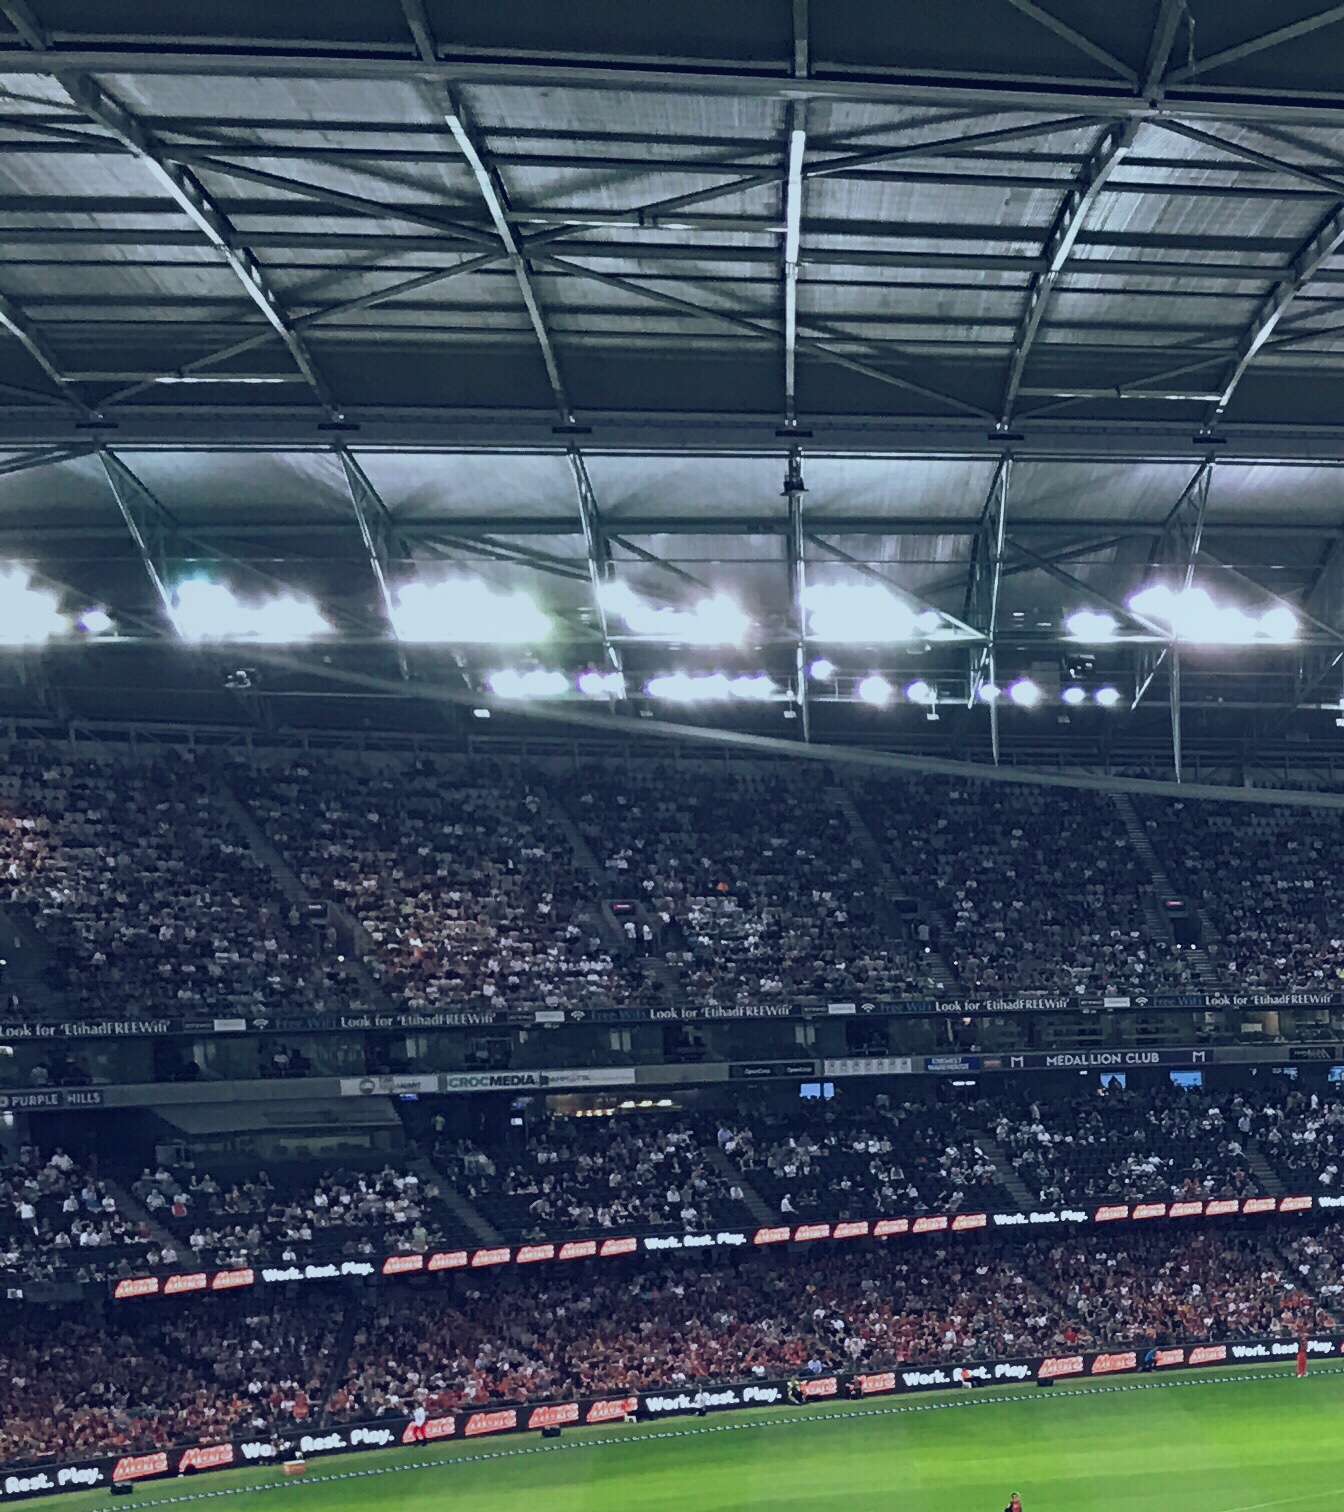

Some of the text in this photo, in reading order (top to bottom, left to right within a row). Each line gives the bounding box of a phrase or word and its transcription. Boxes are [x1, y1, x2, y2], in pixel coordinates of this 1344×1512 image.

[1046, 1054, 1121, 1066] MEDALLION
[1126, 1053, 1160, 1064] CLUB
[448, 1074, 535, 1089] CROCMEDIA
[12, 1092, 100, 1106] PURPLE HILLS
[1232, 1345, 1270, 1357] Work.
[903, 1364, 1031, 1386] Work. Play.
[744, 1387, 781, 1402] Play.
[300, 1433, 346, 1455] Rest.
[351, 1428, 394, 1445] Play.
[6, 1467, 103, 1493] Rest. Play.
